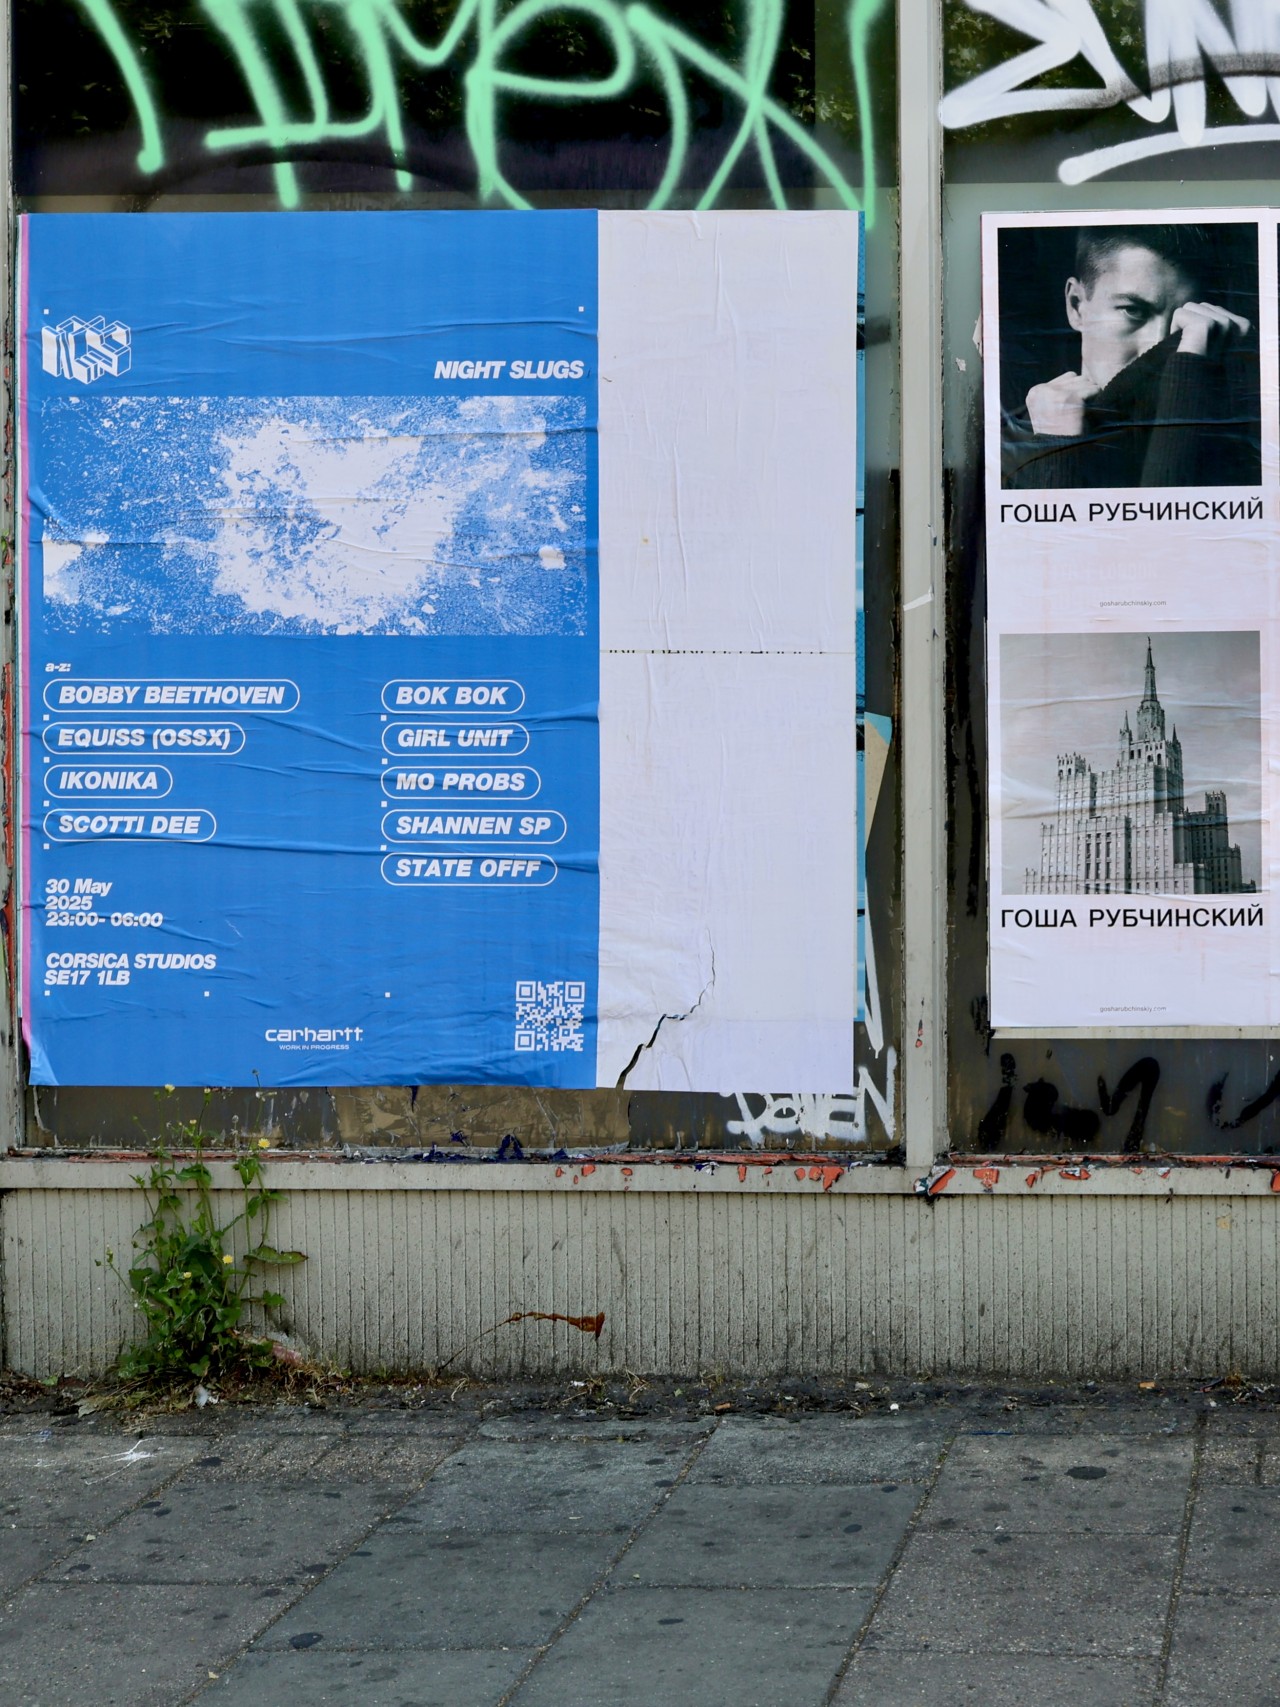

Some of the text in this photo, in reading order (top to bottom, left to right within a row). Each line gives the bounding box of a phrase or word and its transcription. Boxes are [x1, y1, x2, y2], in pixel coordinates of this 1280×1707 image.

[434, 360, 585, 379] NIGHT SLUGS
[1000, 496, 1263, 523] ГОША РУБЧИНСКИЙ
[45, 662, 71, 672] a-z:
[59, 686, 285, 704] BOBBY BEETHOVEN
[395, 686, 510, 705] BOK BOK
[57, 728, 231, 750] EQUISS (OSSX)
[397, 728, 514, 748] GIRL UNIT
[59, 771, 159, 790] IKONIKA
[395, 773, 526, 791] MO PROBS
[58, 816, 201, 834] SCOTTI DEE
[396, 816, 551, 835] SHANNEN SP
[395, 859, 541, 878] STATE OFFF
[45, 878, 112, 897] 30 May
[45, 895, 93, 910] 2025
[110, 912, 164, 927] 06:00
[1001, 903, 1264, 928] ГОША РУБЧИНСКИЙ
[46, 952, 217, 969] CORSICA STUDIOS
[44, 970, 131, 985] SE17 1LB
[265, 1027, 363, 1042] carhartt
